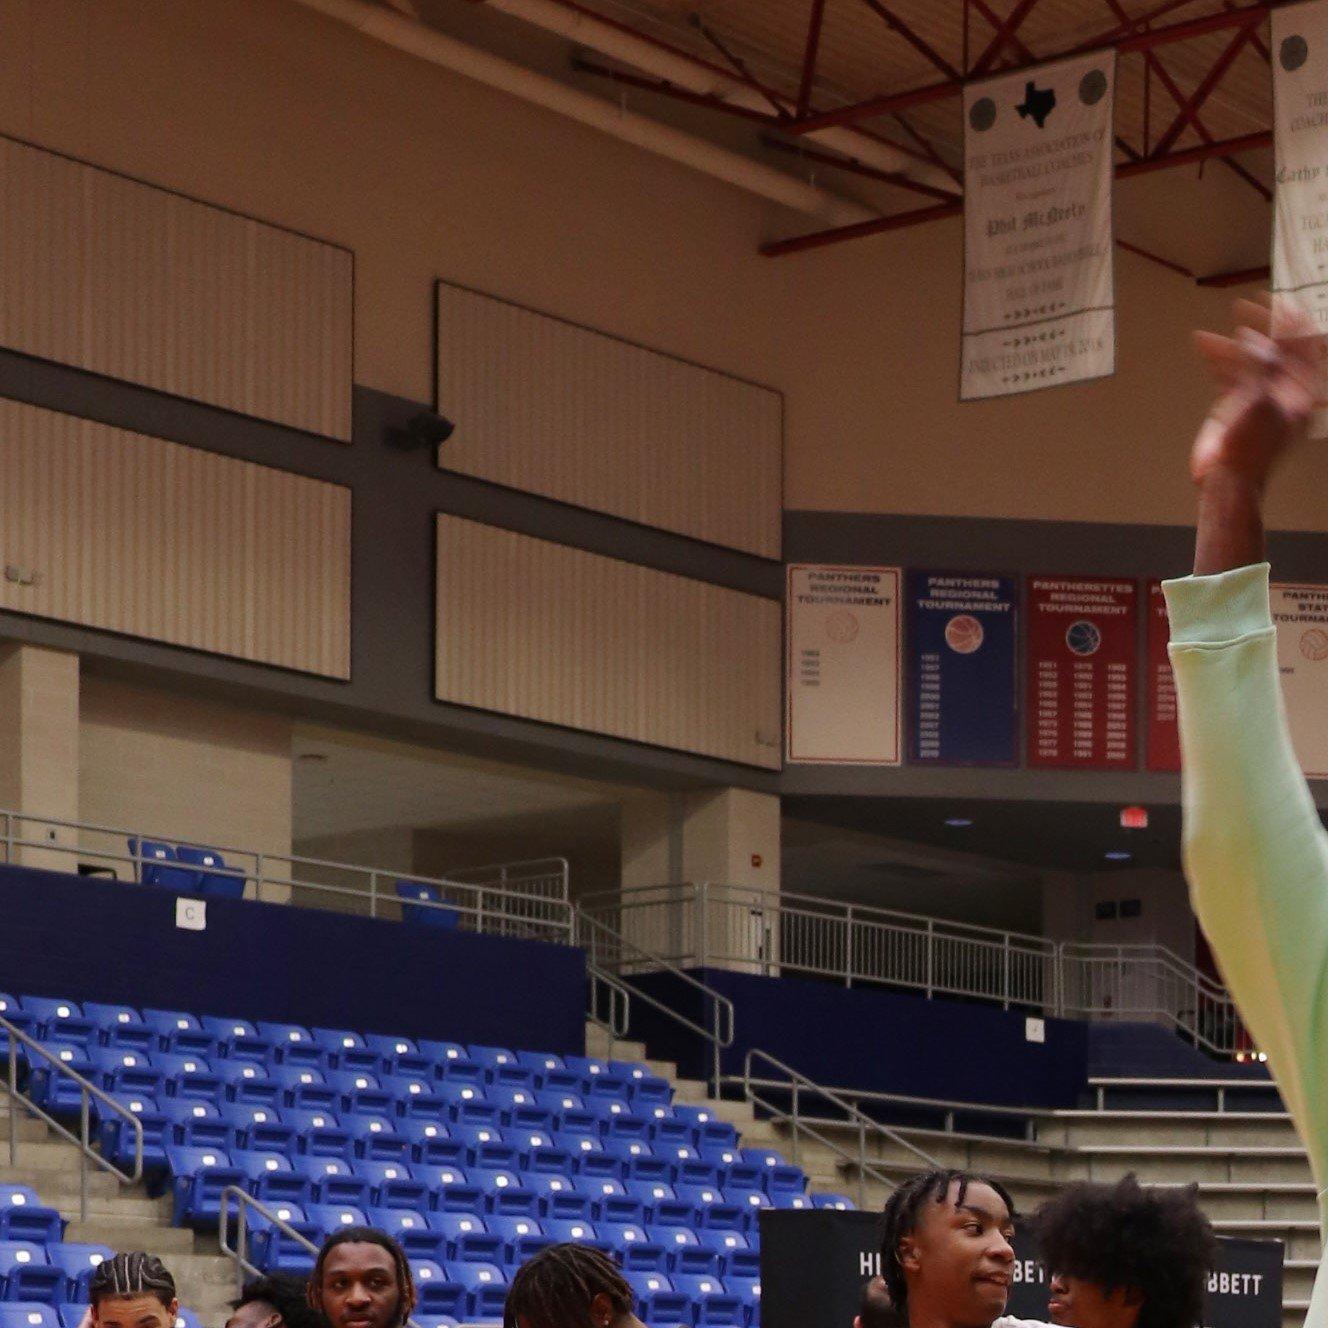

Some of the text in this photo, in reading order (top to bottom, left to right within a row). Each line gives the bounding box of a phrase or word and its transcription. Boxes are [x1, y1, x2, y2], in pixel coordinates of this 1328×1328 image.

[808, 571, 881, 583] PANTHERS
[927, 577, 1000, 589] PANTHERS
[1033, 580, 1133, 594] PANTHERETTES
[797, 594, 892, 606] TOURNAMENT
[929, 589, 999, 601] REGIONAL
[1050, 592, 1115, 604] REGIONAL
[916, 600, 1012, 613] TOURNAMENT
[1038, 603, 1129, 616] TOURNAMENT
[1207, 1272, 1264, 1296] BBETT
